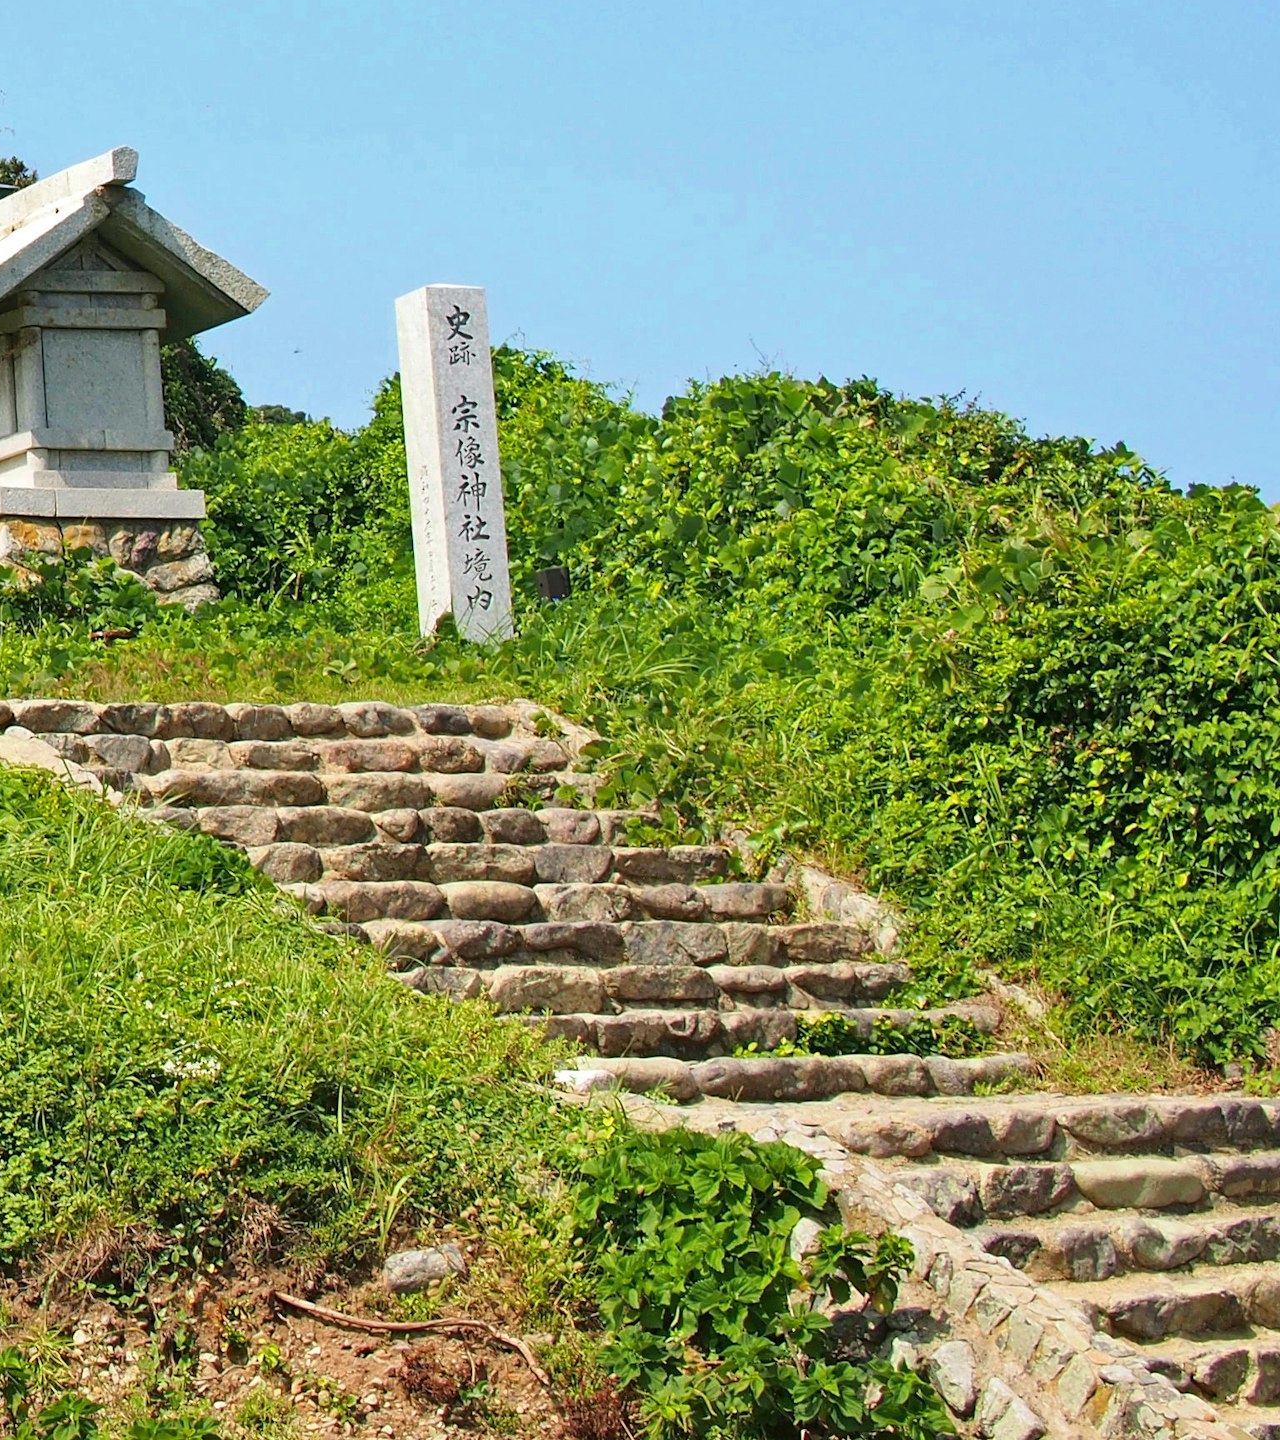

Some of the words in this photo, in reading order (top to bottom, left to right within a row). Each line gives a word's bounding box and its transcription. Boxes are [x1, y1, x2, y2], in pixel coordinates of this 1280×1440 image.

[450, 394, 494, 613] 宗像神社境内
